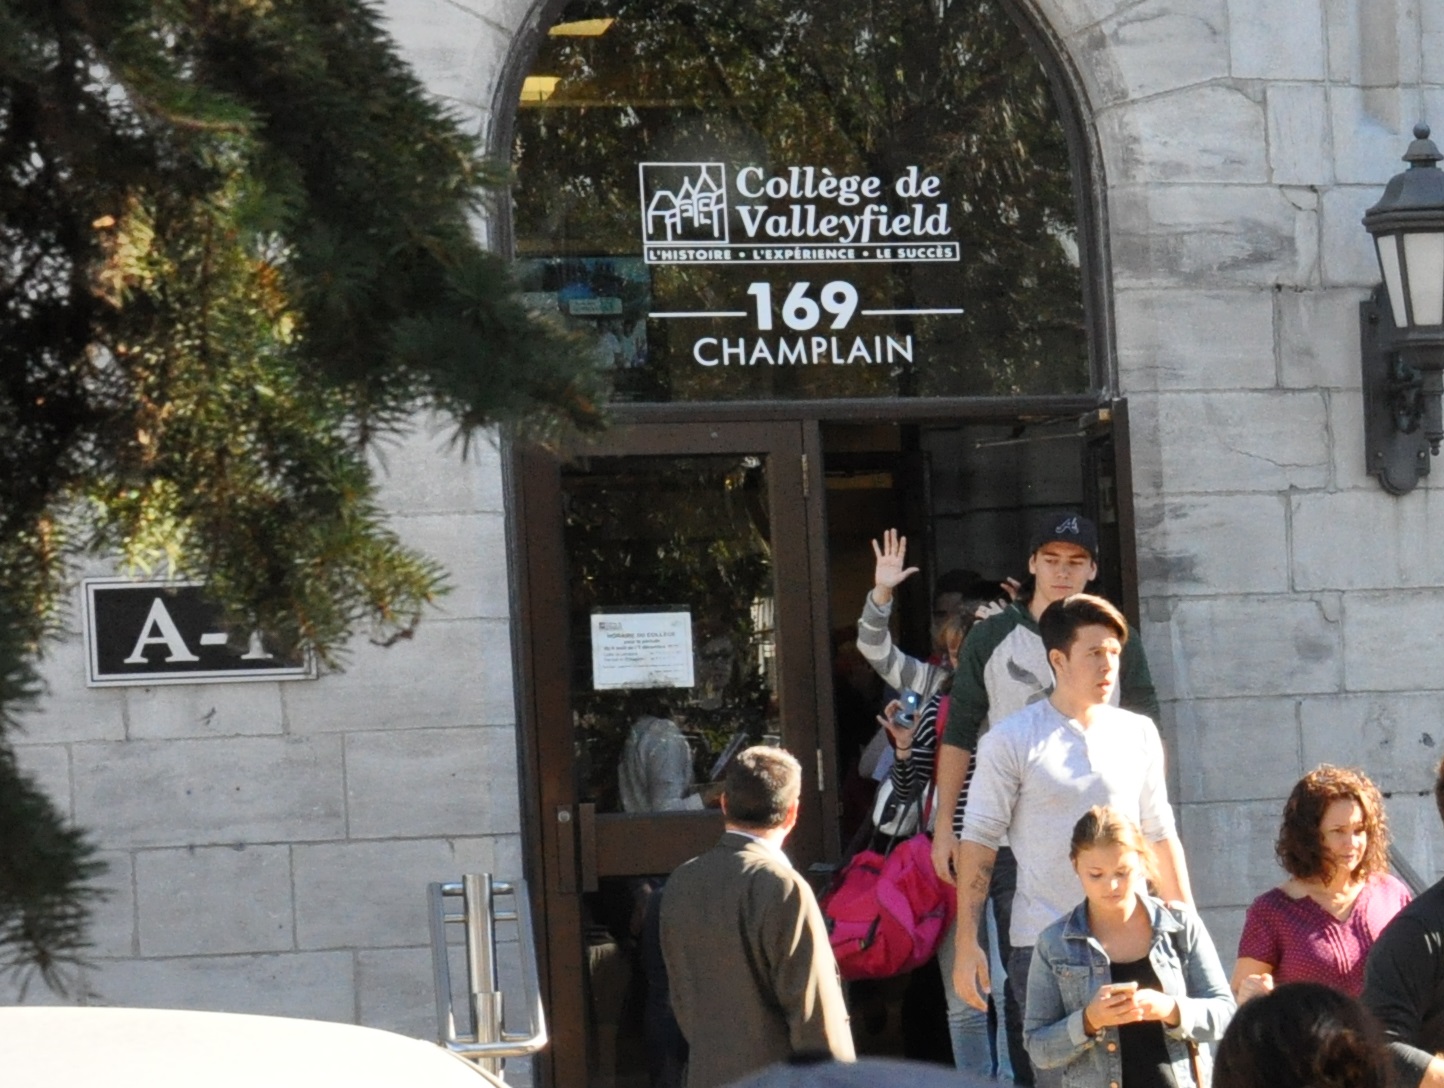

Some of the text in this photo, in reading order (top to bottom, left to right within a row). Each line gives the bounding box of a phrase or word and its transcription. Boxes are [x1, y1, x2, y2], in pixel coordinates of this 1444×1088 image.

[736, 166, 940, 206] Collège de
[736, 203, 951, 243] Valleyfield
[649, 245, 953, 261] L'HISTOIRE L'EXPÉRIENCE LE SUCCÈS
[747, 281, 859, 331] 169
[693, 335, 913, 366] CHAMPLAIN
